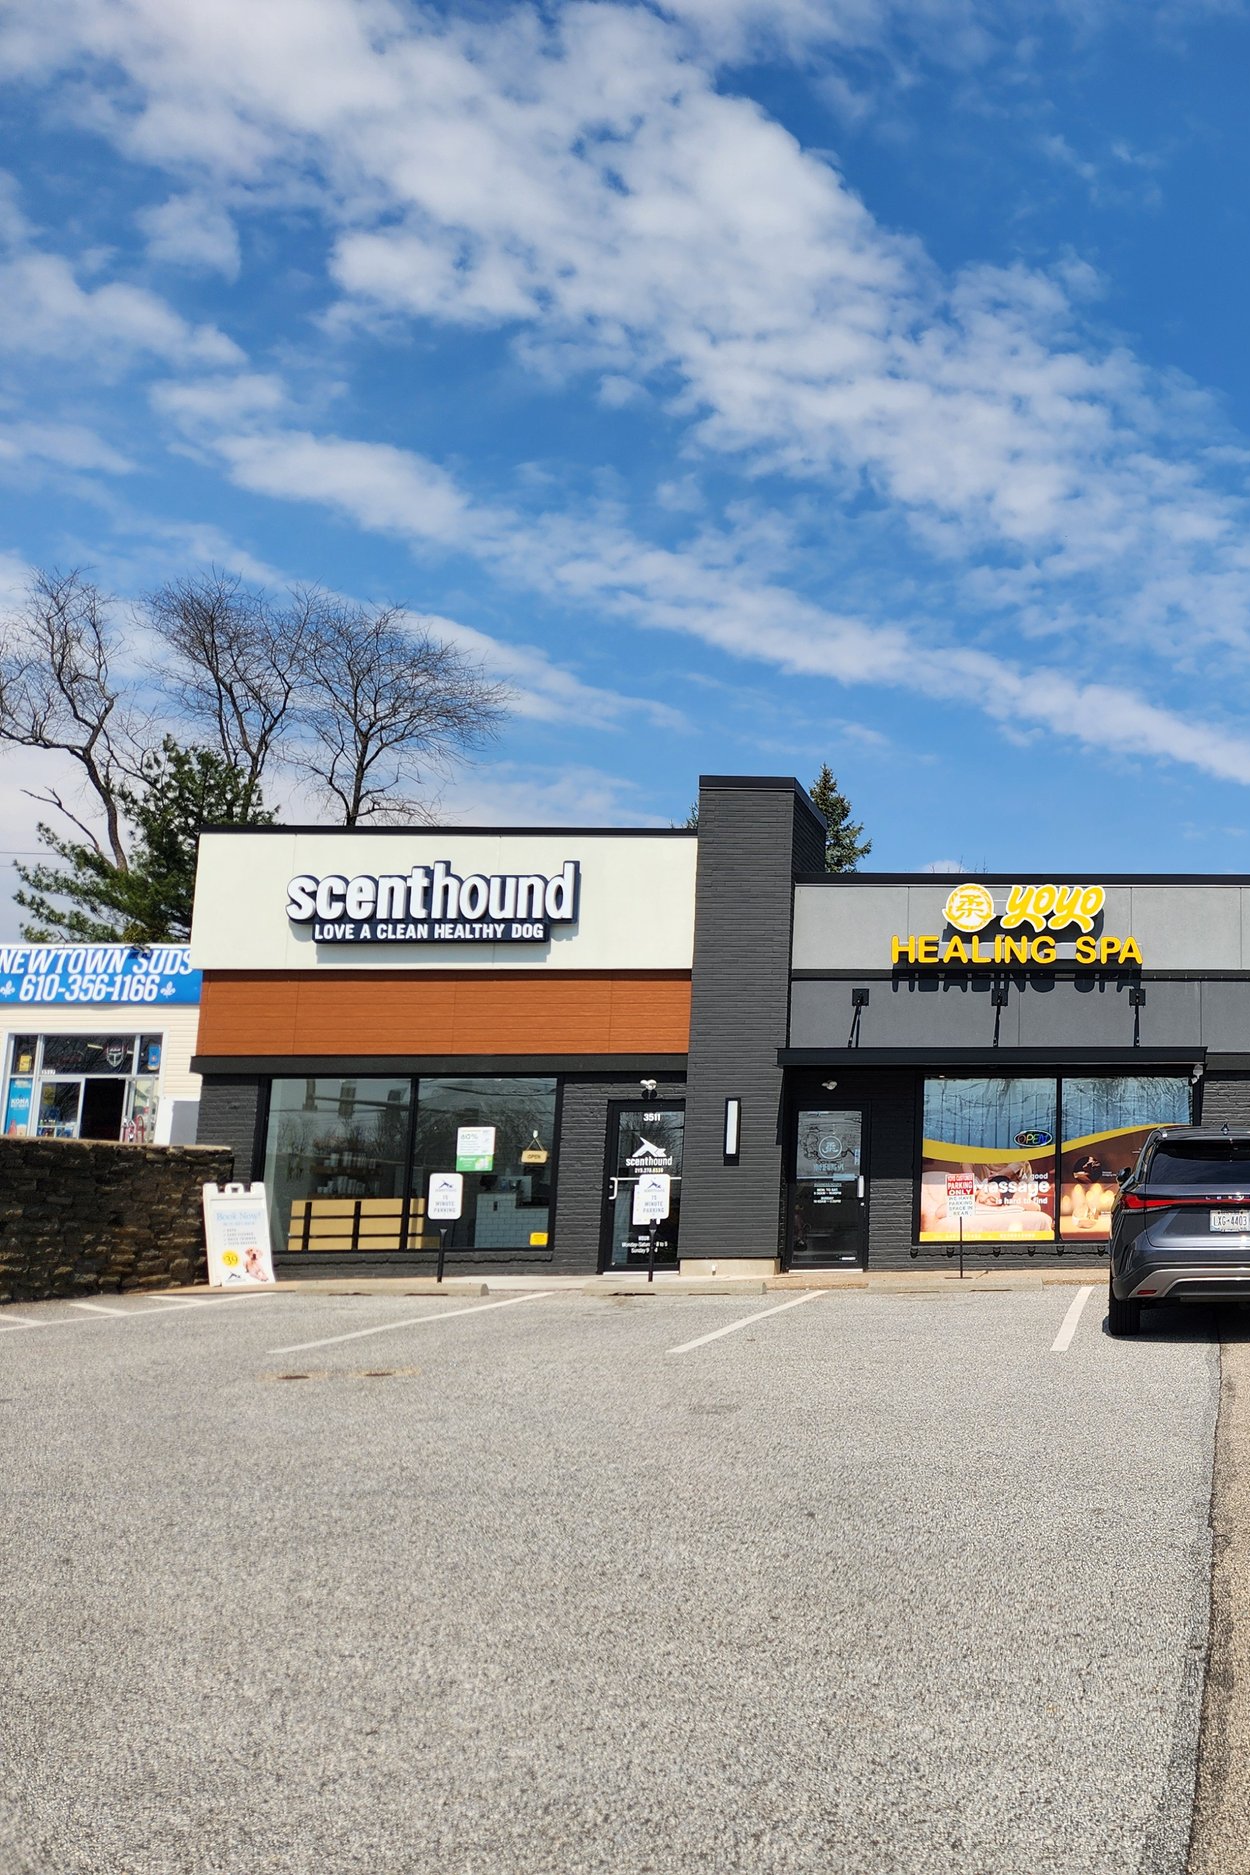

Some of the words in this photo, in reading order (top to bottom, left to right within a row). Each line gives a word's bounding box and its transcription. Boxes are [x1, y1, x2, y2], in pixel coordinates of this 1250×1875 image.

[286, 860, 577, 921] scenthound
[315, 924, 354, 940] LOVE
[360, 924, 371, 940] A
[376, 924, 428, 940] CLEAN
[434, 923, 505, 939] HEALTHY
[511, 923, 544, 939] DOG
[891, 935, 1057, 964] HEALING
[1075, 935, 1143, 964] SPA
[0, 949, 127, 974] NEWTOWN
[132, 948, 193, 975] SUDS
[19, 974, 160, 1001] 610-356-1166
[643, 1112, 661, 1122] 3511
[1017, 1133, 1048, 1145] OPEN
[625, 1155, 673, 1167] scenthound
[1030, 1172, 1049, 1182] good
[947, 1181, 973, 1190] PARKING
[975, 1180, 1050, 1197] Massage
[1003, 1196, 1021, 1205] hard
[1032, 1196, 1048, 1205] find
